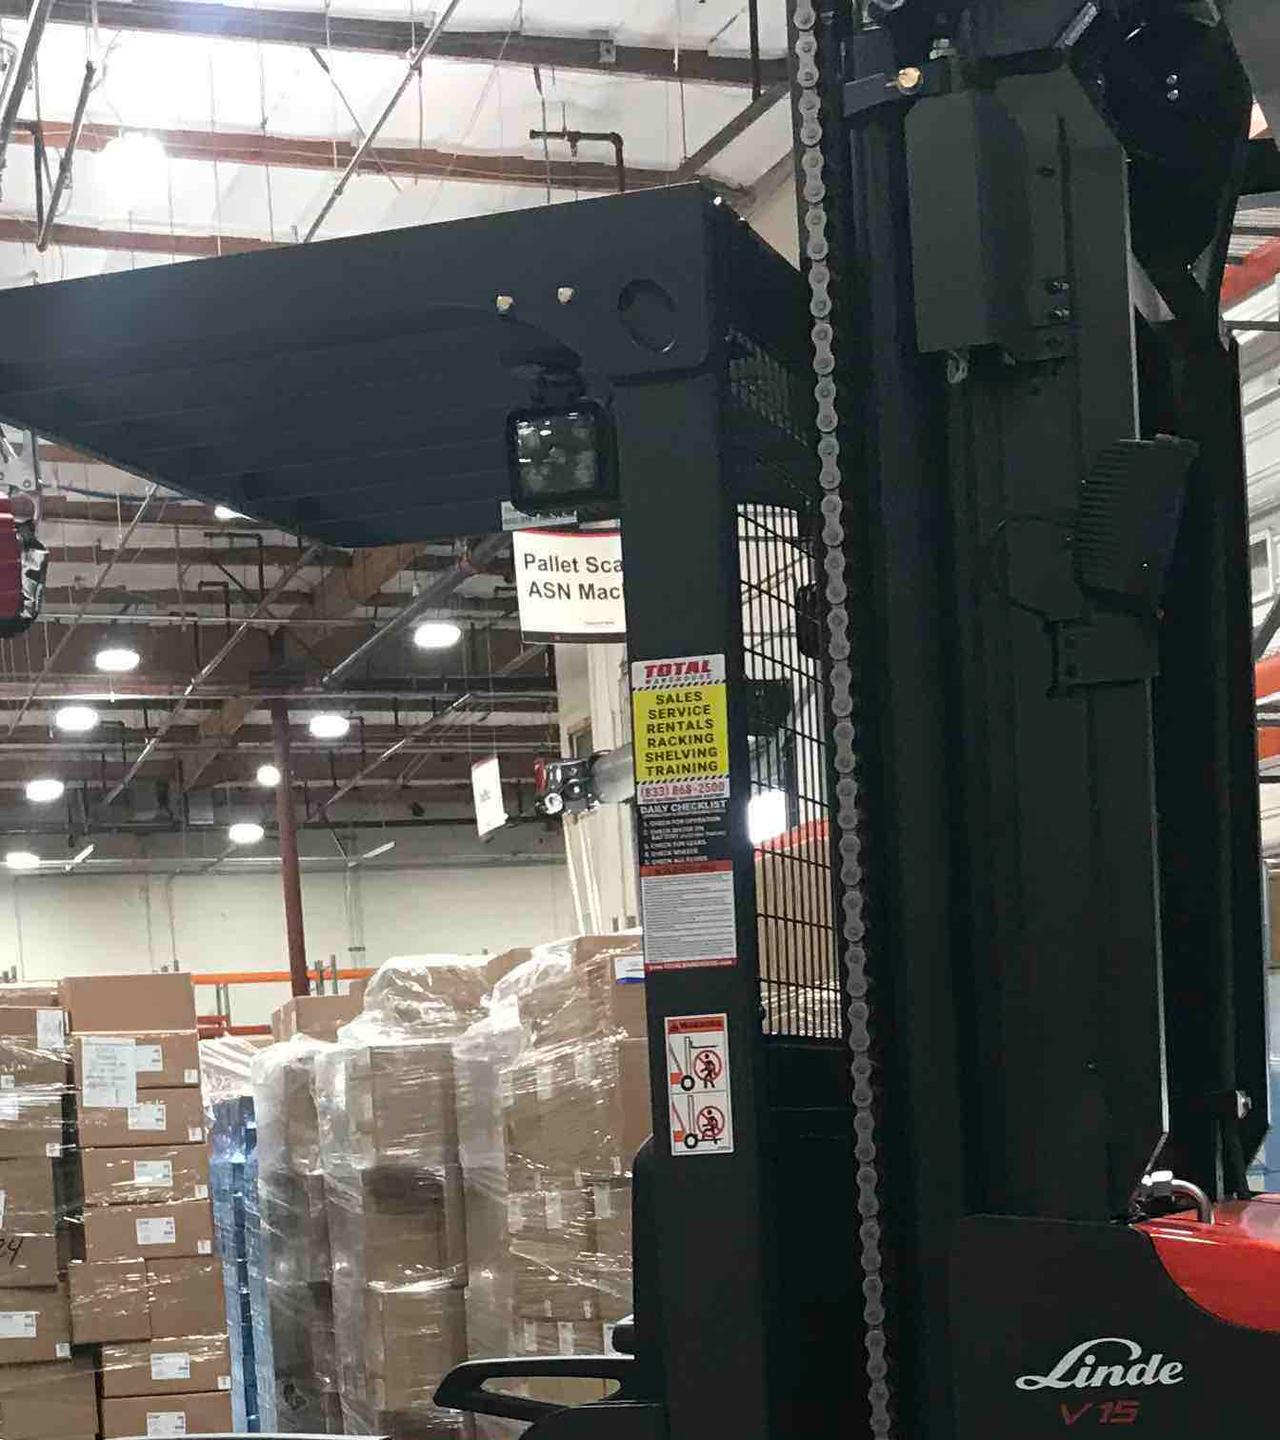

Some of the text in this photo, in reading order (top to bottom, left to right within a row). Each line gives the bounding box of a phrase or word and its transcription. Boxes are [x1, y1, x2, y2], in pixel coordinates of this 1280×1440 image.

[524, 553, 580, 573] Pallet
[528, 581, 571, 600] ASN
[645, 660, 712, 678] TOTAL
[656, 691, 703, 705] SALES
[648, 704, 711, 719] SERVICE
[647, 719, 714, 734] RENTALS
[647, 733, 715, 749] RACKING
[645, 746, 718, 763] SHELVING
[644, 760, 718, 777] TRAINING
[670, 800, 727, 812] CHECKLIST
[1015, 1337, 1184, 1390] Linde
